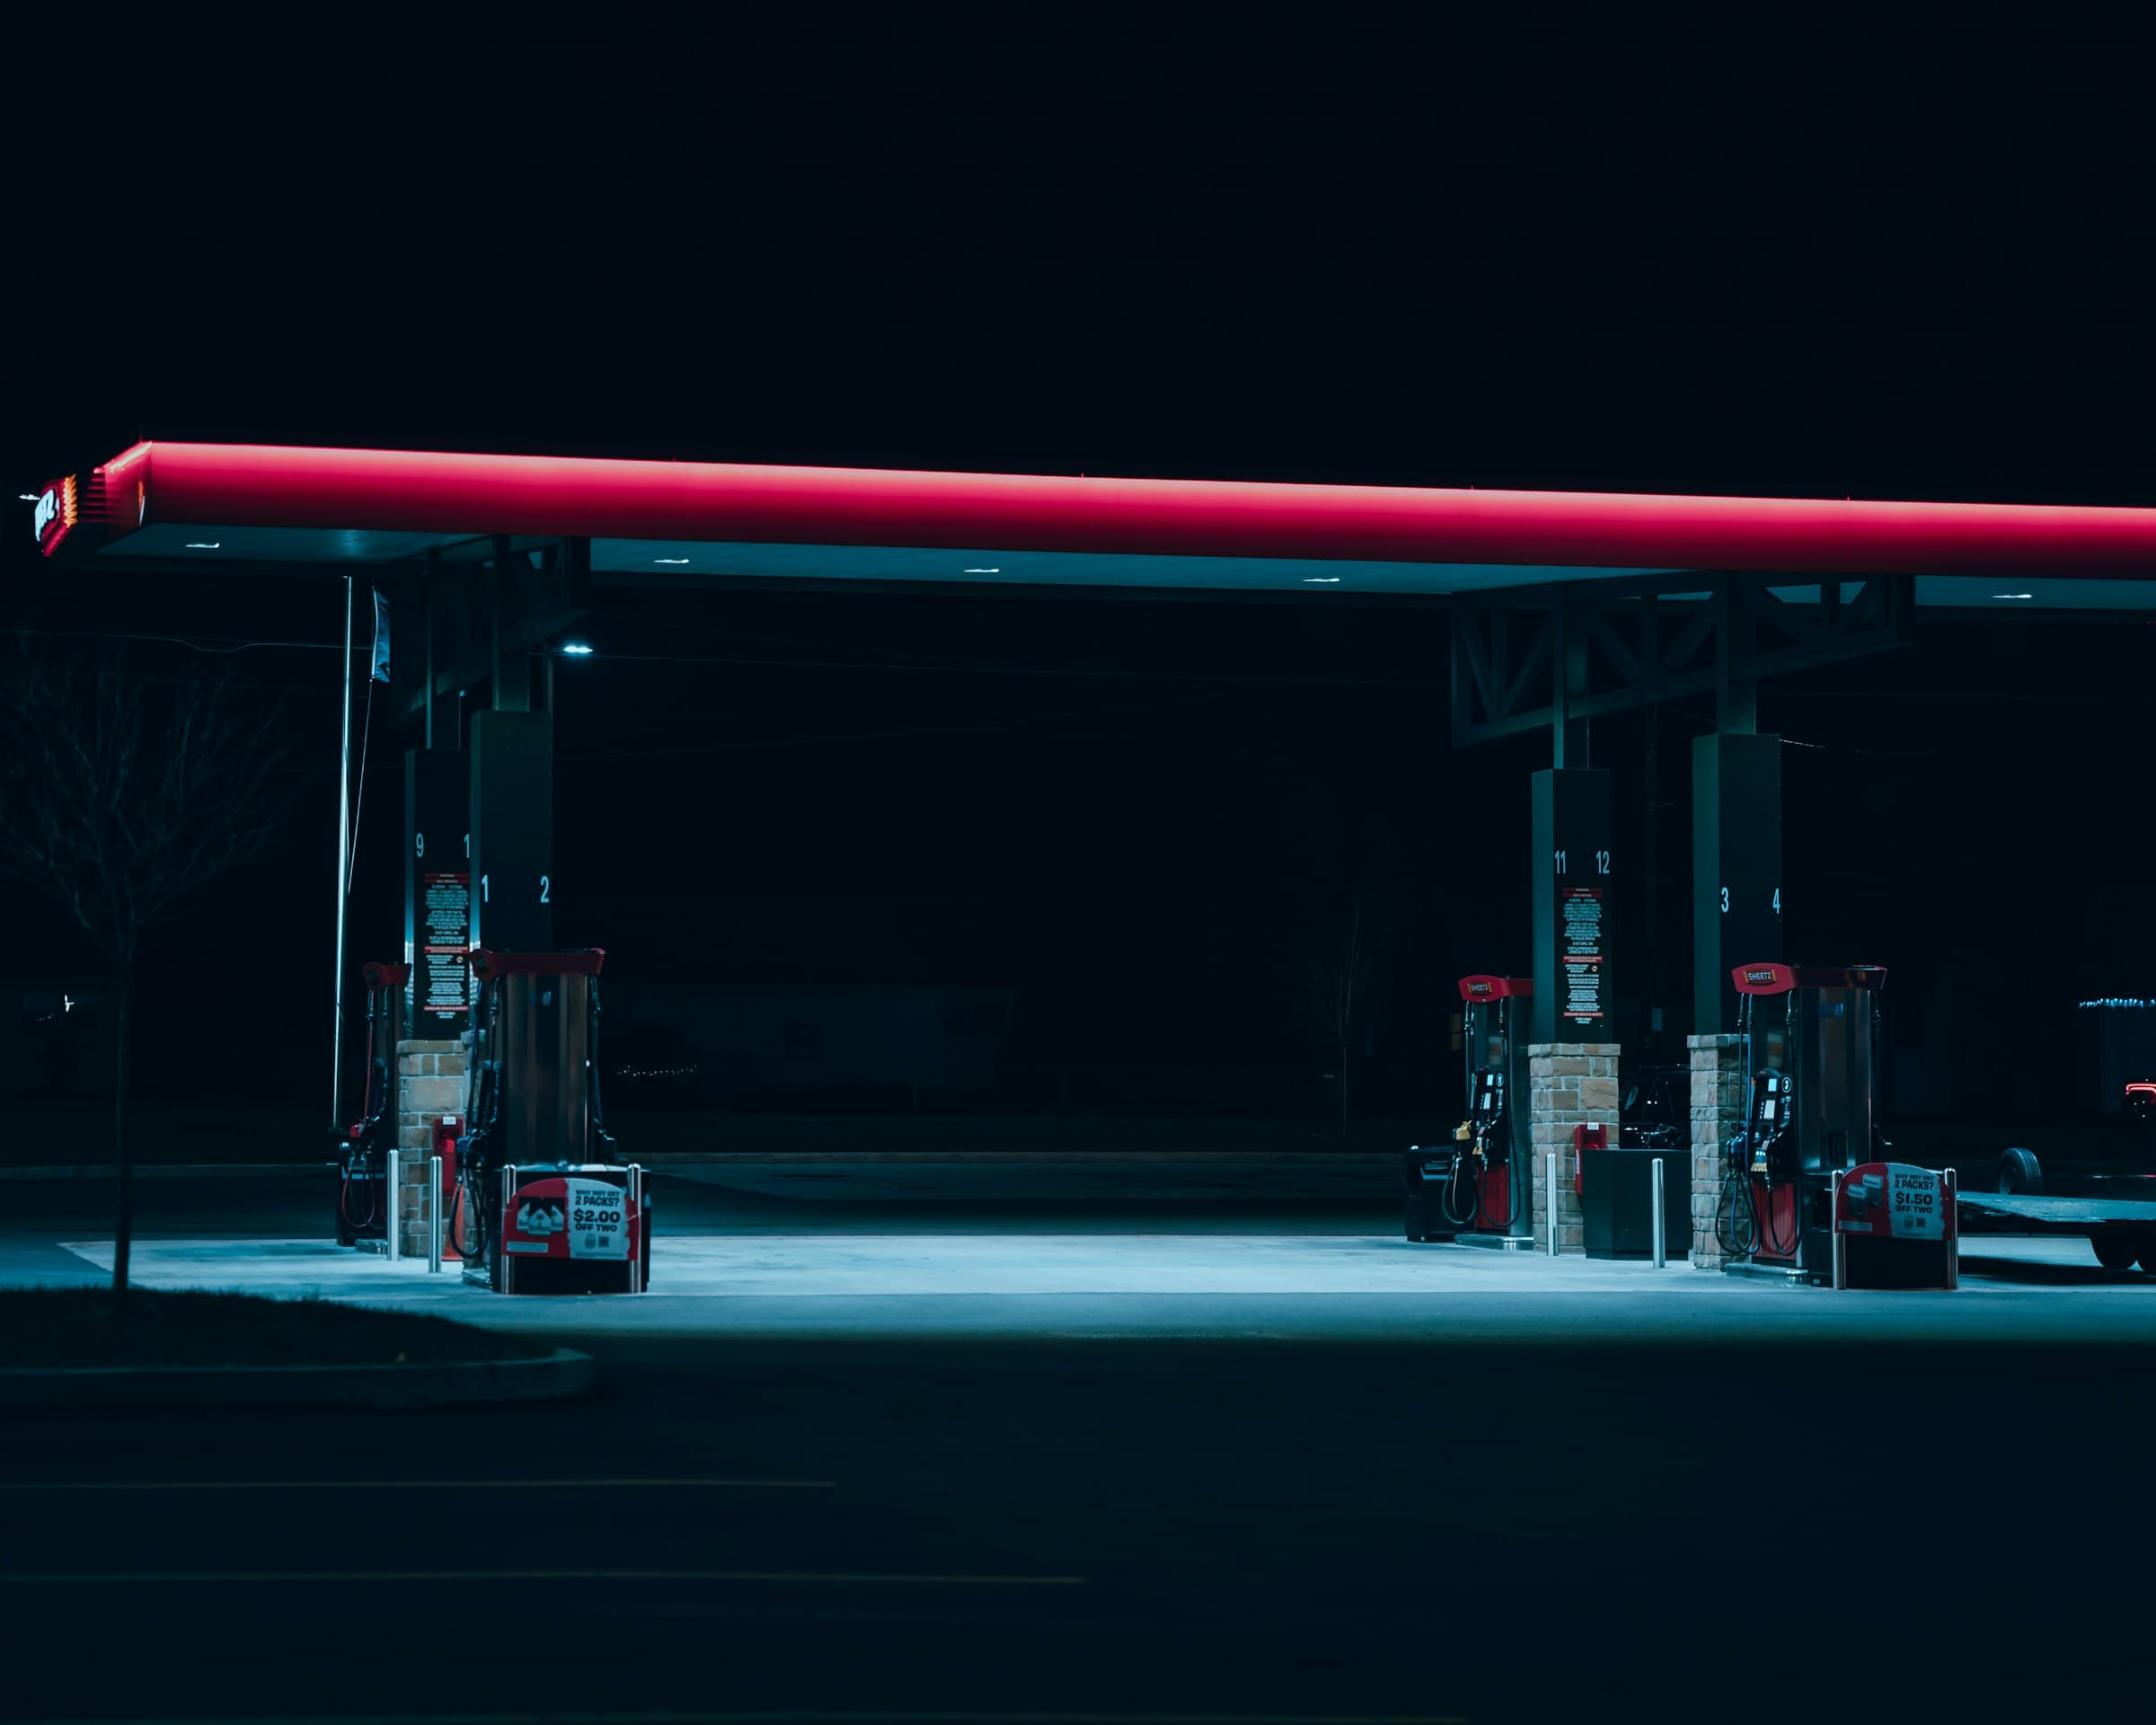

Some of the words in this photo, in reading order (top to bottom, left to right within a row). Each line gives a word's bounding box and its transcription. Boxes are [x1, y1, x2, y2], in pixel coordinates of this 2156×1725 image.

[416, 832, 424, 858] 9
[1554, 850, 1567, 875] 11
[1595, 850, 1611, 875] 12
[481, 873, 490, 903] 1
[540, 875, 550, 904] 2
[1720, 886, 1729, 913] 3
[1772, 888, 1780, 914] 4
[1747, 971, 1772, 981] SHEETZ
[1895, 1179, 1900, 1188] 2
[1902, 1180, 1934, 1190] PACKS?
[575, 1196, 581, 1205] 2
[583, 1196, 620, 1207] PACKS?
[1895, 1190, 1933, 1206] $1.50
[573, 1208, 621, 1223] $2.00
[1895, 1205, 1912, 1213] OFF
[1913, 1206, 1933, 1214] TWO
[575, 1223, 594, 1231] OFF
[596, 1224, 617, 1232] TWO
